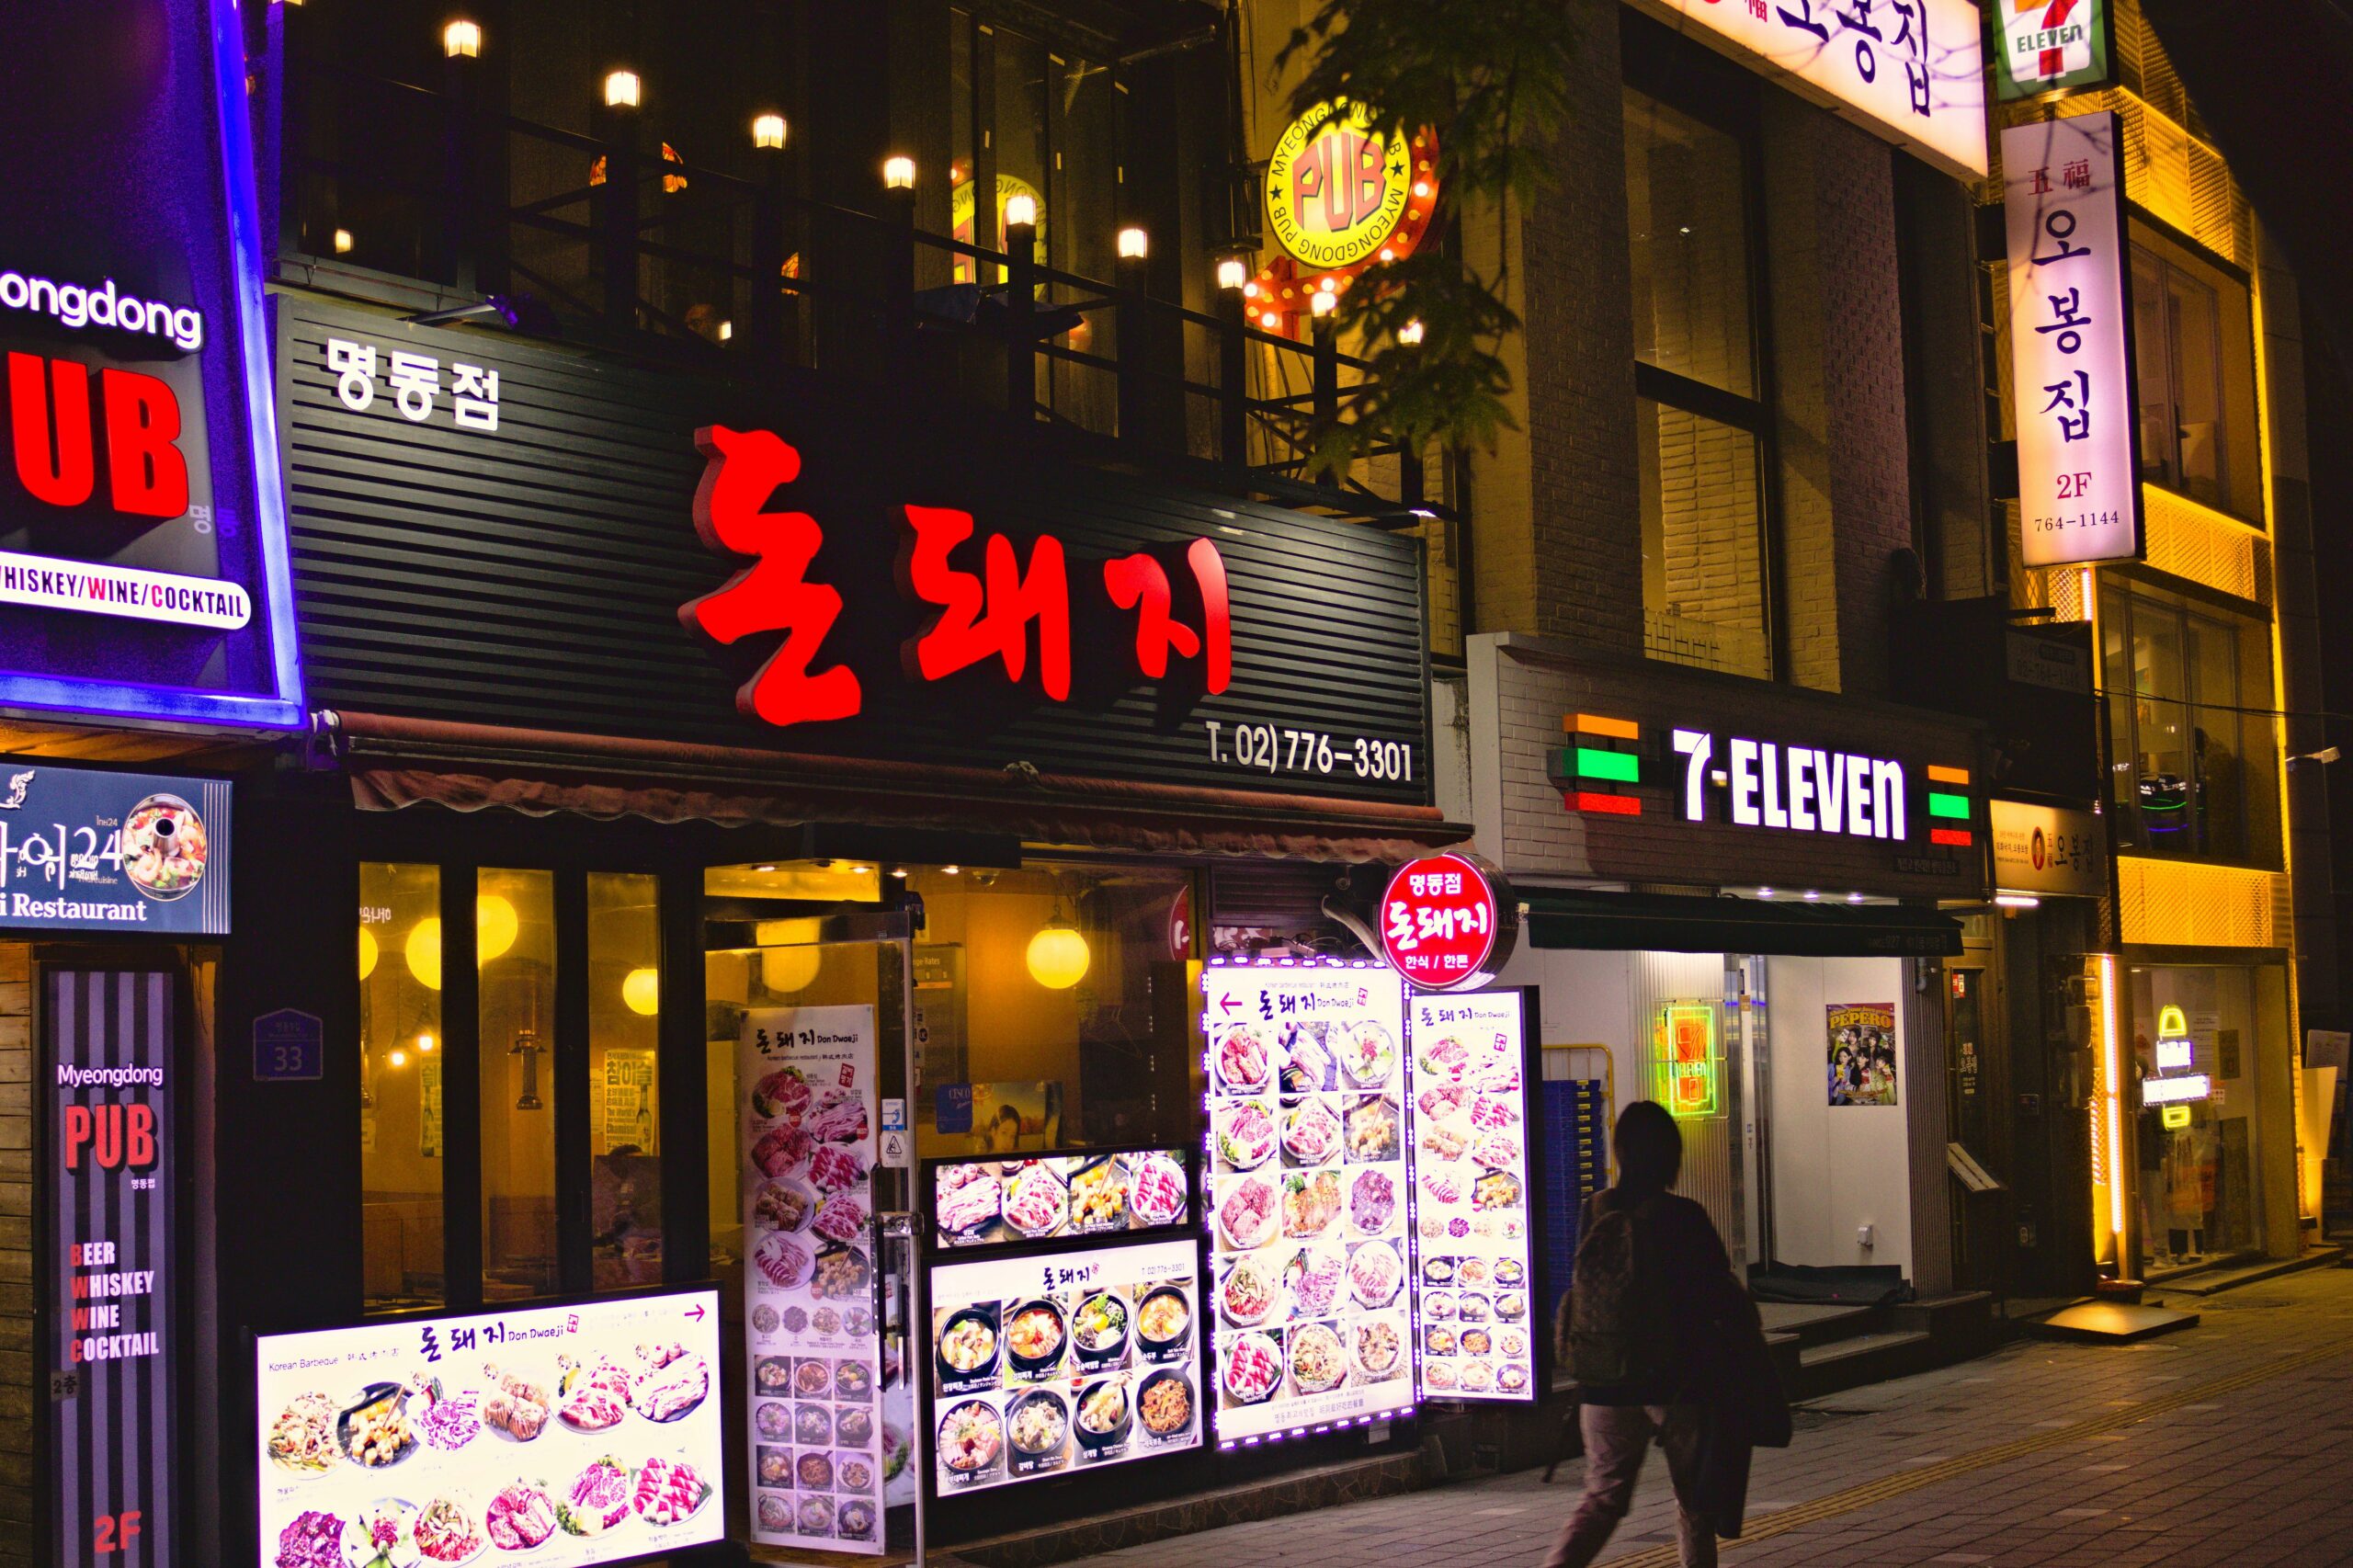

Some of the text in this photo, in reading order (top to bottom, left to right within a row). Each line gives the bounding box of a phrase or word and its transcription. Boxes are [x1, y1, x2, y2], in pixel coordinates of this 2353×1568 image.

[1292, 132, 1387, 233] PUB
[2030, 209, 2092, 443] 오봉집
[327, 337, 499, 431] 명동점
[8, 350, 189, 517] UB
[2056, 472, 2093, 500] 2F
[2034, 510, 2120, 533] 764-1144
[1409, 873, 1461, 896] 명동점
[12, 893, 147, 921] Restaurant
[1404, 955, 1429, 969] 한식
[1830, 1013, 1892, 1029] PEPERO
[817, 1035, 832, 1043] Don
[833, 1034, 858, 1044] Dwaeji
[274, 1046, 302, 1072] 33
[58, 1063, 163, 1087] Myeongdong
[65, 1104, 153, 1169] PUB
[70, 1242, 116, 1267] BEER
[70, 1271, 154, 1299] WHISKEY
[71, 1304, 119, 1331] WINE
[508, 1331, 528, 1342] Don
[529, 1325, 563, 1339] Dwaeji
[70, 1332, 159, 1363] COCKTAIL
[269, 1361, 298, 1372] Korean
[95, 1510, 142, 1553] 2F
